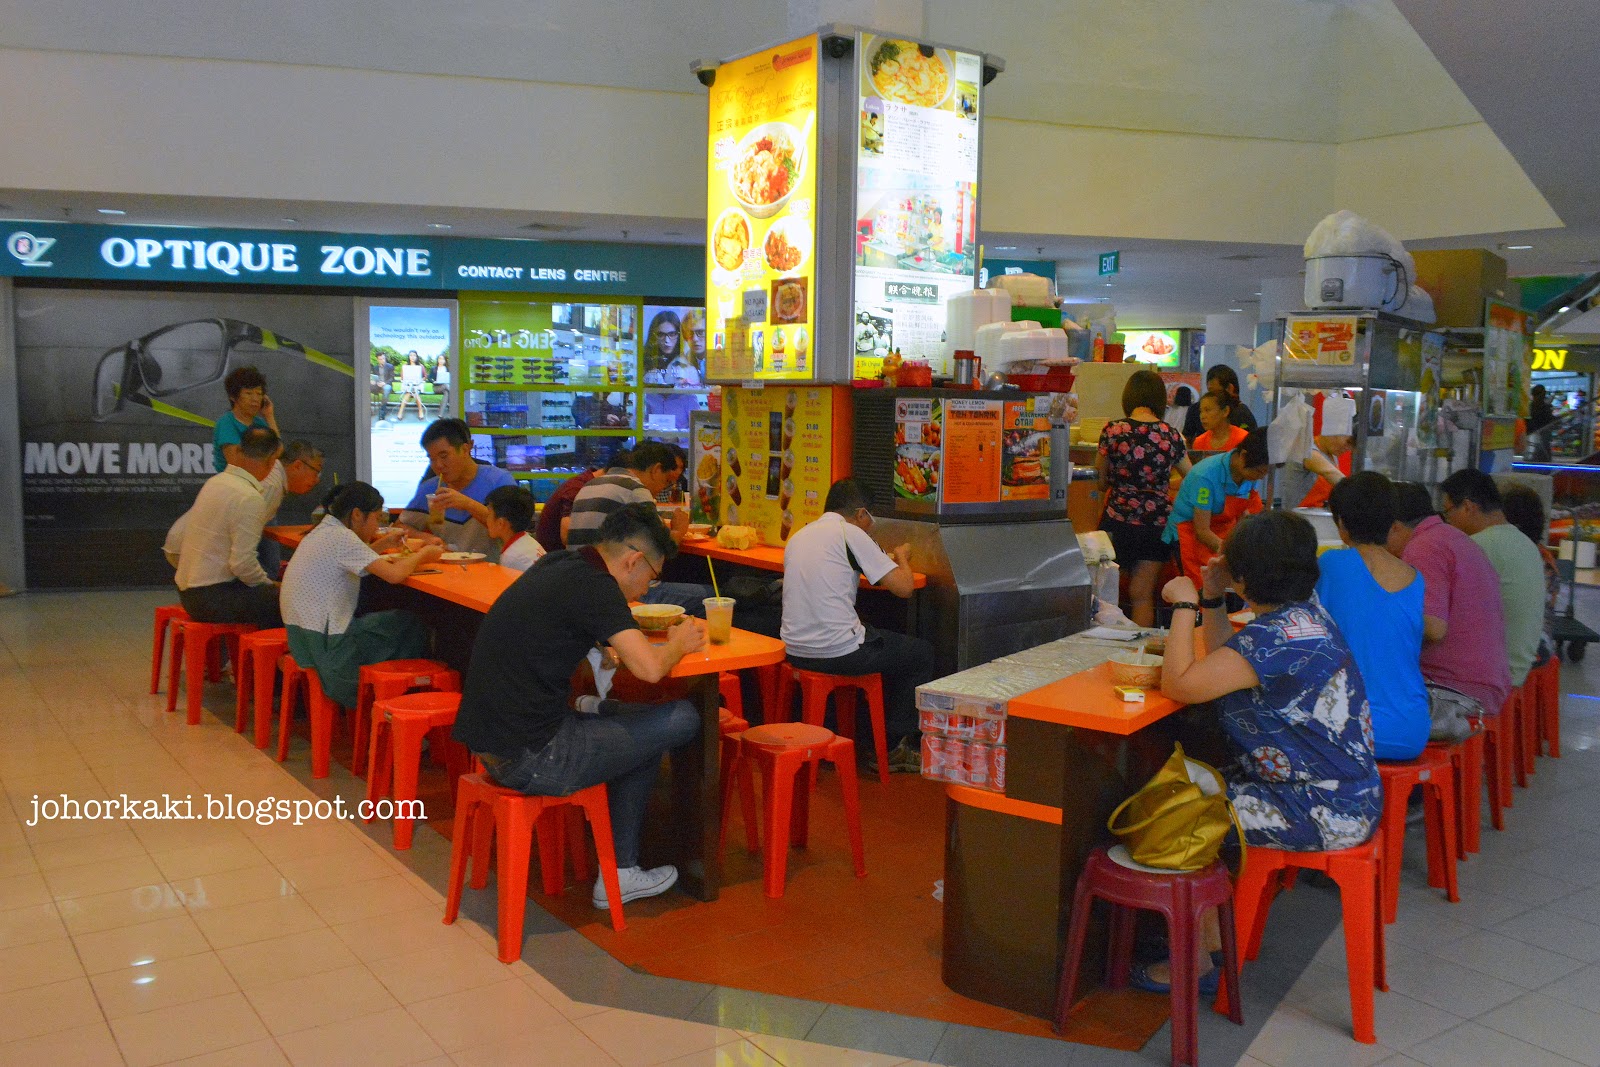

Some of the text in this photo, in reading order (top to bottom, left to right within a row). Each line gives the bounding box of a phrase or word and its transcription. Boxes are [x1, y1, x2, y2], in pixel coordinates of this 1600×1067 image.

[101, 238, 431, 277] OPTIQUE ZONE
[1102, 256, 1116, 272] EXIT
[457, 265, 627, 283] CONTACT LENS CENTRE
[23, 442, 217, 474] MOVE MORE
